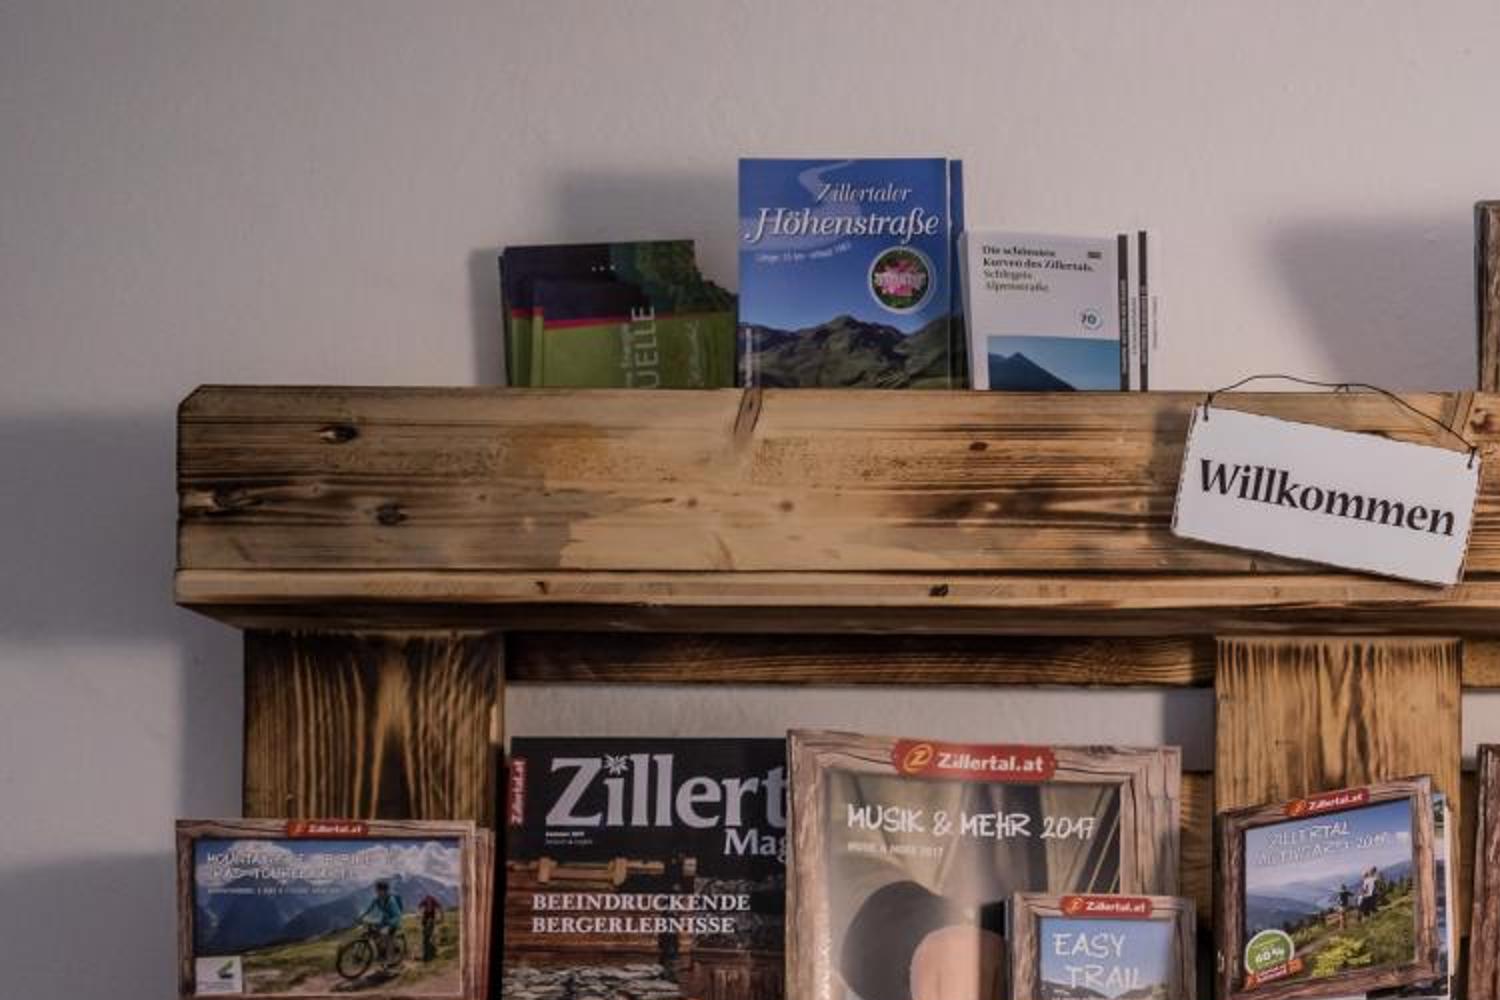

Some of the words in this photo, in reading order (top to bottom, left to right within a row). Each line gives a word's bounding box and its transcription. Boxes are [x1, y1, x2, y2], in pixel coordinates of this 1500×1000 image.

[815, 182, 913, 203] Zillertaler
[744, 206, 940, 245] Höhenstraße
[1024, 259, 1042, 269] des
[1200, 459, 1455, 536] Willkommen
[936, 752, 1044, 772] Zillertal.at
[847, 803, 924, 833] MUSIK
[932, 810, 952, 836] &
[960, 811, 1032, 840] MEHR
[1039, 816, 1098, 840] 2017
[531, 893, 751, 912] BEEINDRUCKENDE
[1086, 902, 1145, 912] Zillertal.at
[531, 916, 736, 934] BERGERLEBNISSE
[1053, 933, 1126, 958] EASY
[1065, 964, 1146, 990] TRAIL
